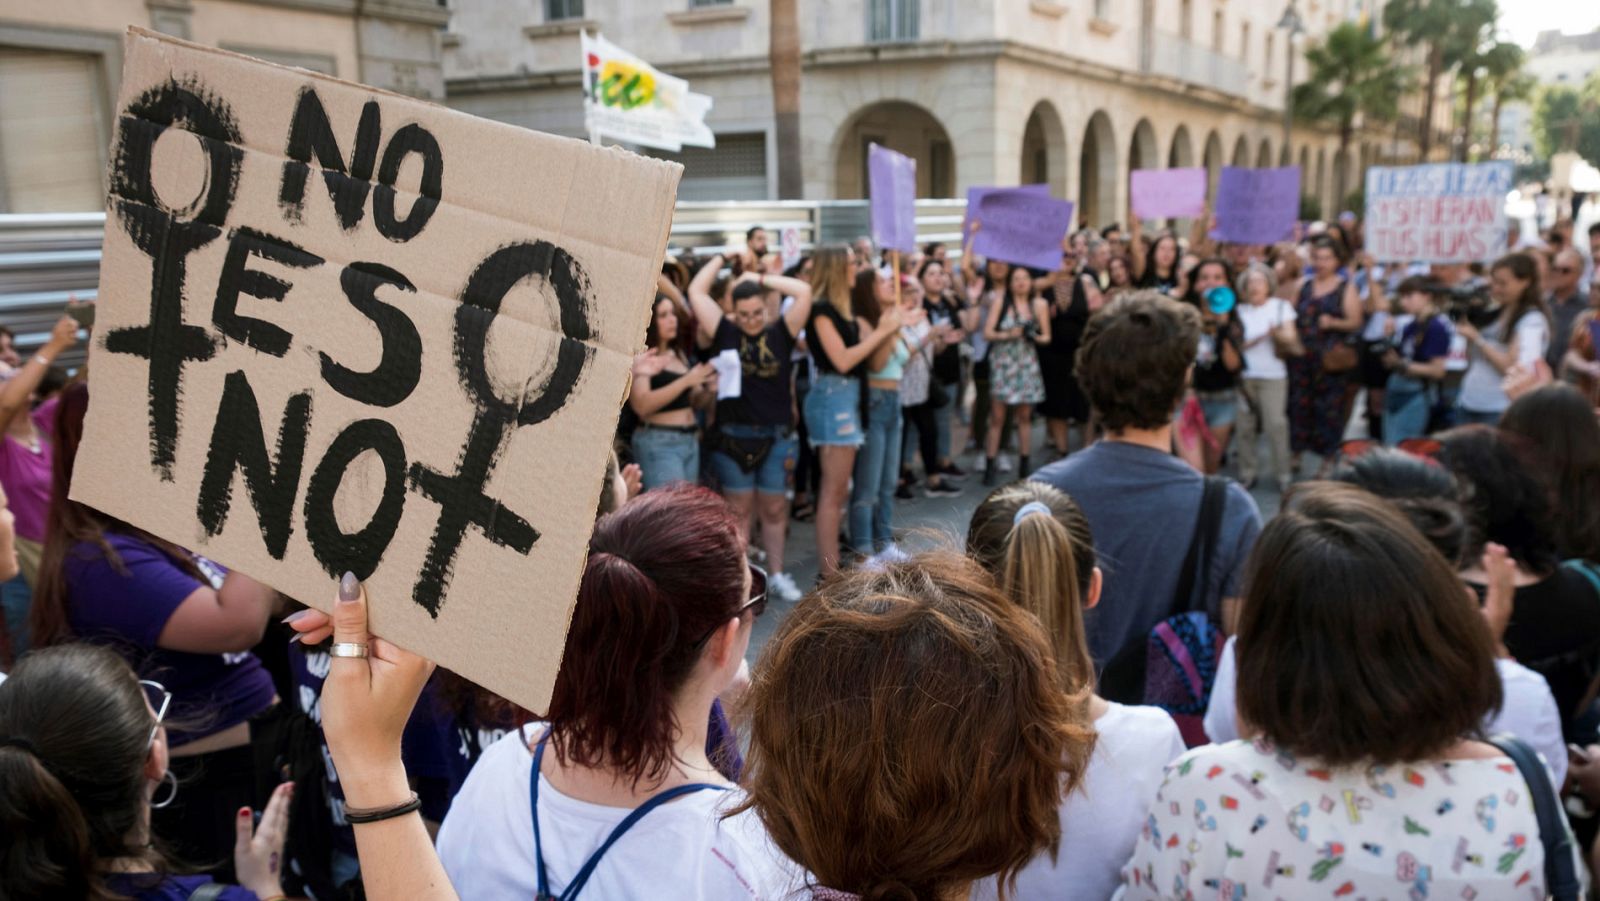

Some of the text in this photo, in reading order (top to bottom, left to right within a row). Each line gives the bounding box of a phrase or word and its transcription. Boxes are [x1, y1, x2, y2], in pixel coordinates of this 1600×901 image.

[279, 87, 443, 243] NO
[1375, 226, 1416, 255] TUS
[211, 226, 423, 408] ES
[197, 369, 407, 583] NO
